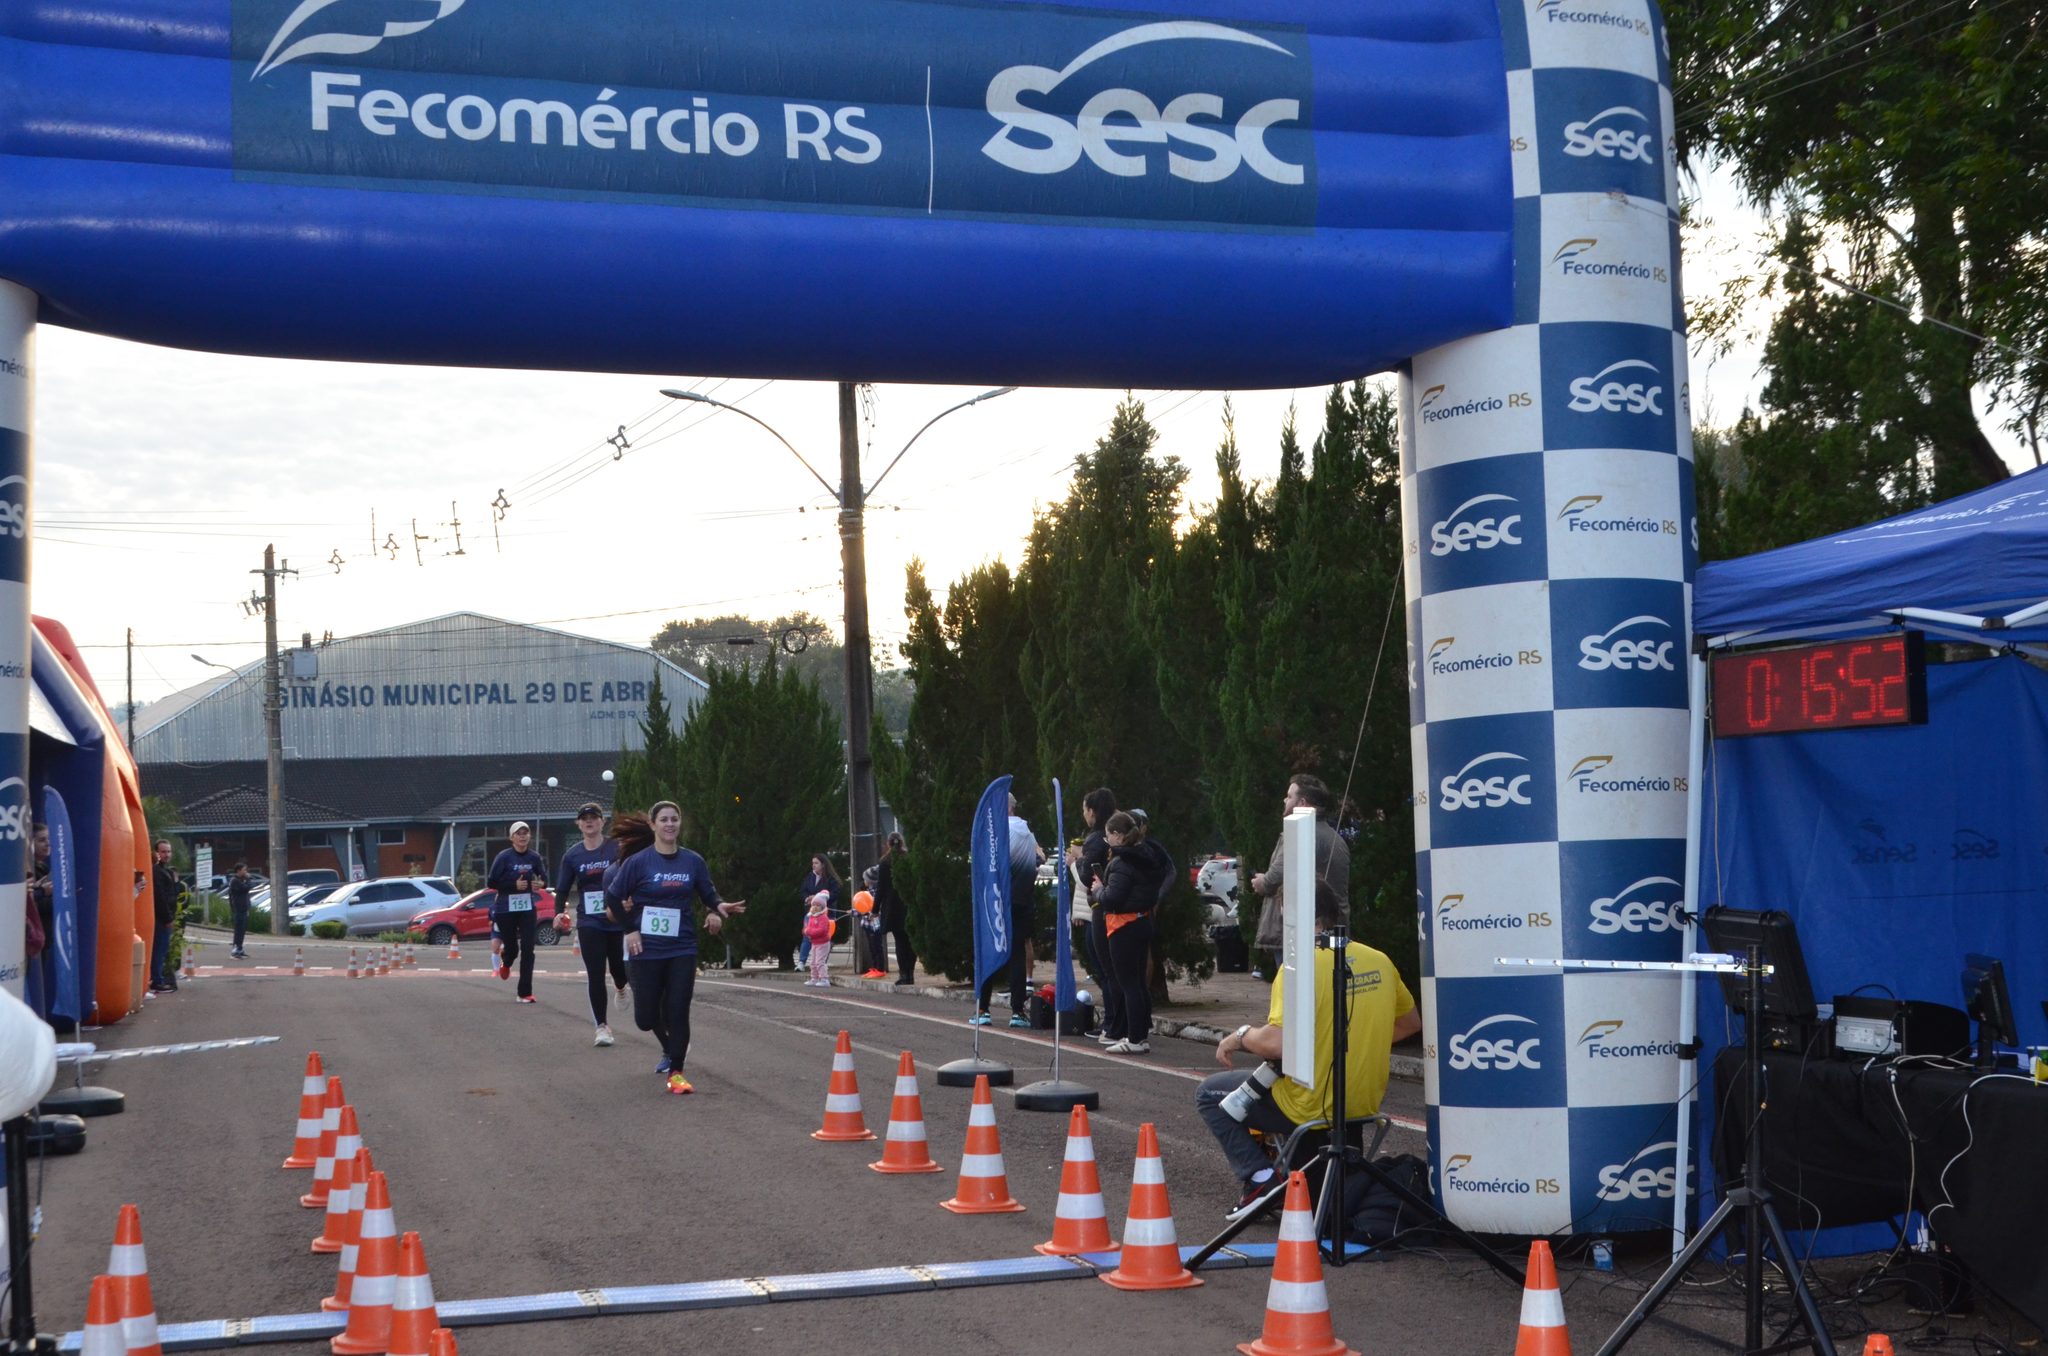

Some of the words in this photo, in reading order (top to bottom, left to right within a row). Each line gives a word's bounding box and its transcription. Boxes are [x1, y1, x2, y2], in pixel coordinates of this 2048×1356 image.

[1548, 9, 1633, 29] Fecomércio
[1635, 19, 1650, 36] RS
[981, 21, 1305, 185] Sesc
[310, 71, 760, 157] Fecomércio
[782, 103, 884, 165] RS
[1562, 106, 1653, 165] Sesc
[1563, 260, 1650, 279] Fecomércio
[1653, 266, 1668, 283] RS
[1567, 359, 1663, 416] Sesc
[1423, 399, 1503, 424] Fecomércio
[1508, 392, 1533, 408] RS
[1430, 494, 1522, 557] Sesc
[1569, 517, 1659, 533] Fecomércio
[1662, 519, 1677, 535] RS
[1577, 615, 1675, 671] Sesc
[1432, 653, 1513, 675] Fecomércio
[1518, 650, 1543, 665] RS
[382, 683, 518, 706] MUNICIPAL
[525, 682, 556, 703] 29
[563, 681, 593, 703] DE
[1746, 641, 1905, 728] 0:15:52
[1439, 752, 1532, 811] Sesc
[1578, 776, 1670, 793] Fecomércio
[1673, 777, 1688, 793] RS
[512, 900, 529, 910] 151
[651, 917, 670, 933] 93
[1441, 912, 1522, 931] Fecomércio
[1527, 912, 1552, 928] RS
[1449, 1014, 1541, 1071] Sesc
[1449, 1176, 1530, 1194] Fecomércio
[1535, 1178, 1560, 1194] RS
